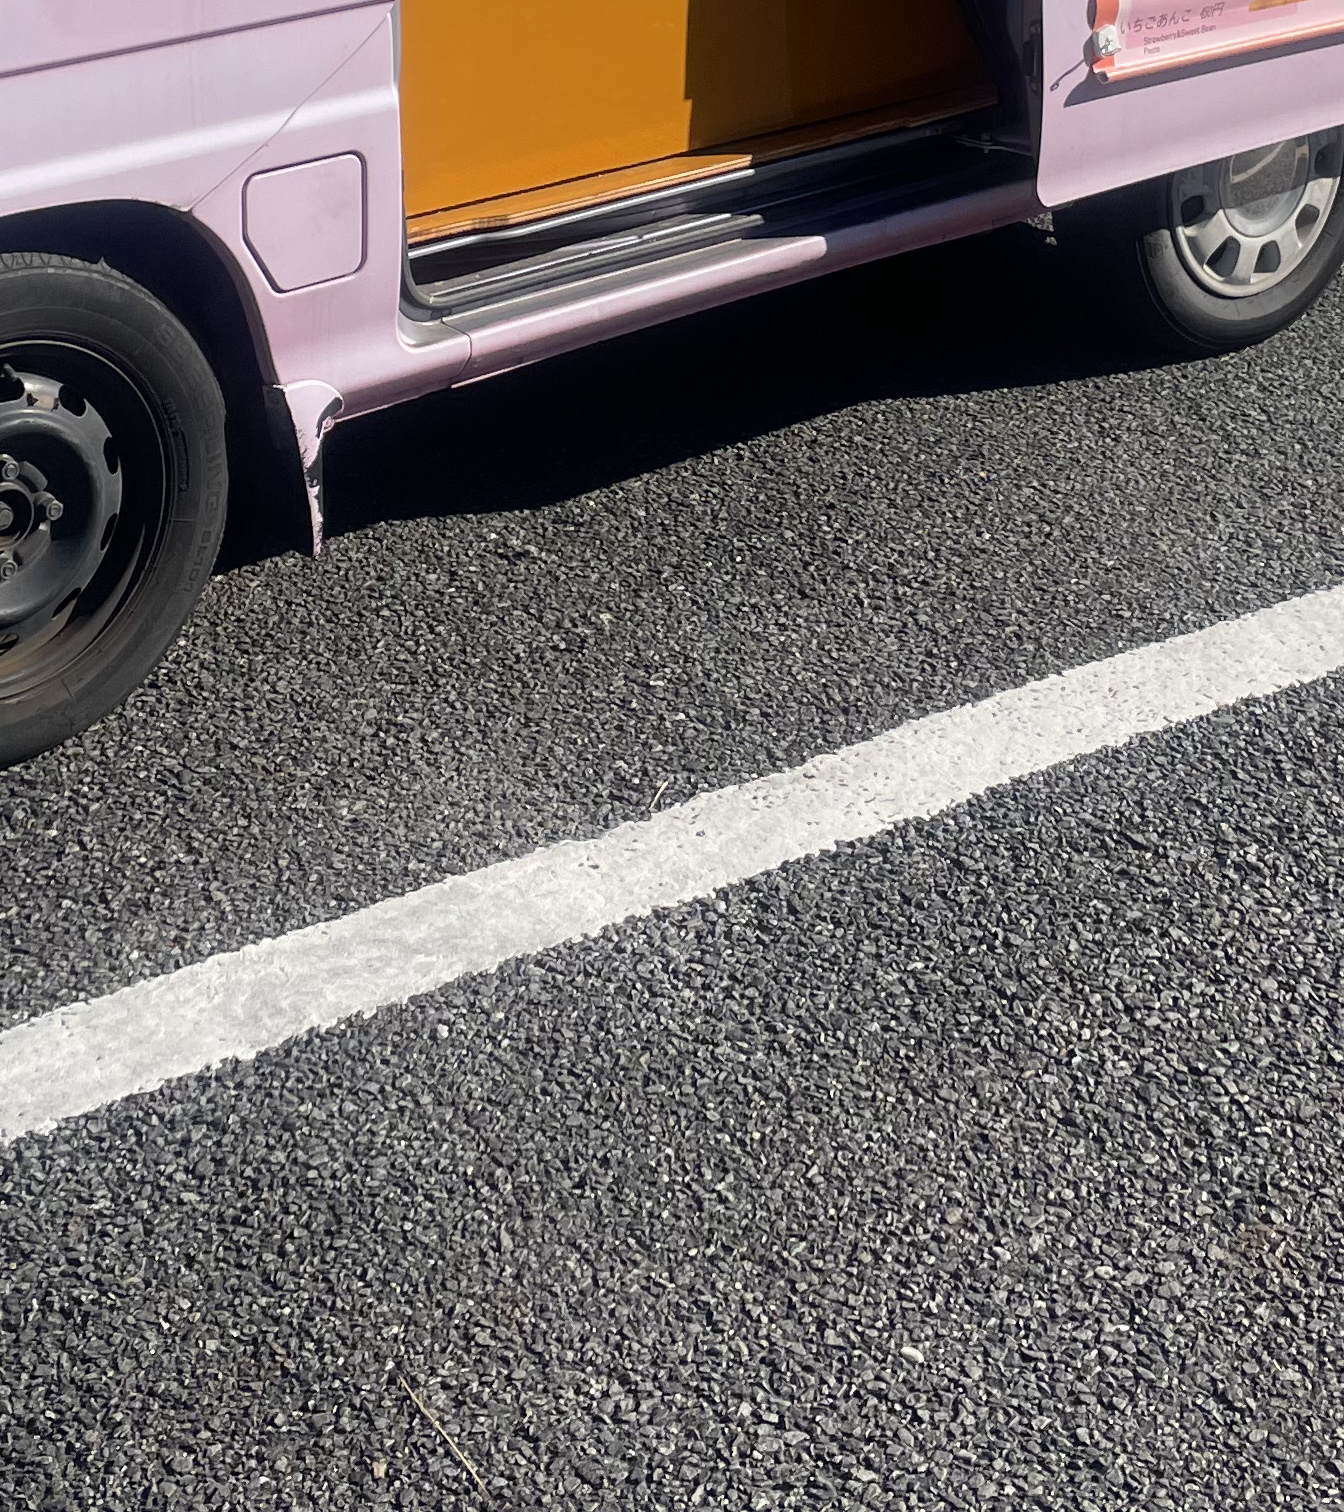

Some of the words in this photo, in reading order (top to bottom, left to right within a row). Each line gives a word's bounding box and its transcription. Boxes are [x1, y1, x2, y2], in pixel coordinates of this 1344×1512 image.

[1120, 8, 1192, 35] いちごあんこ
